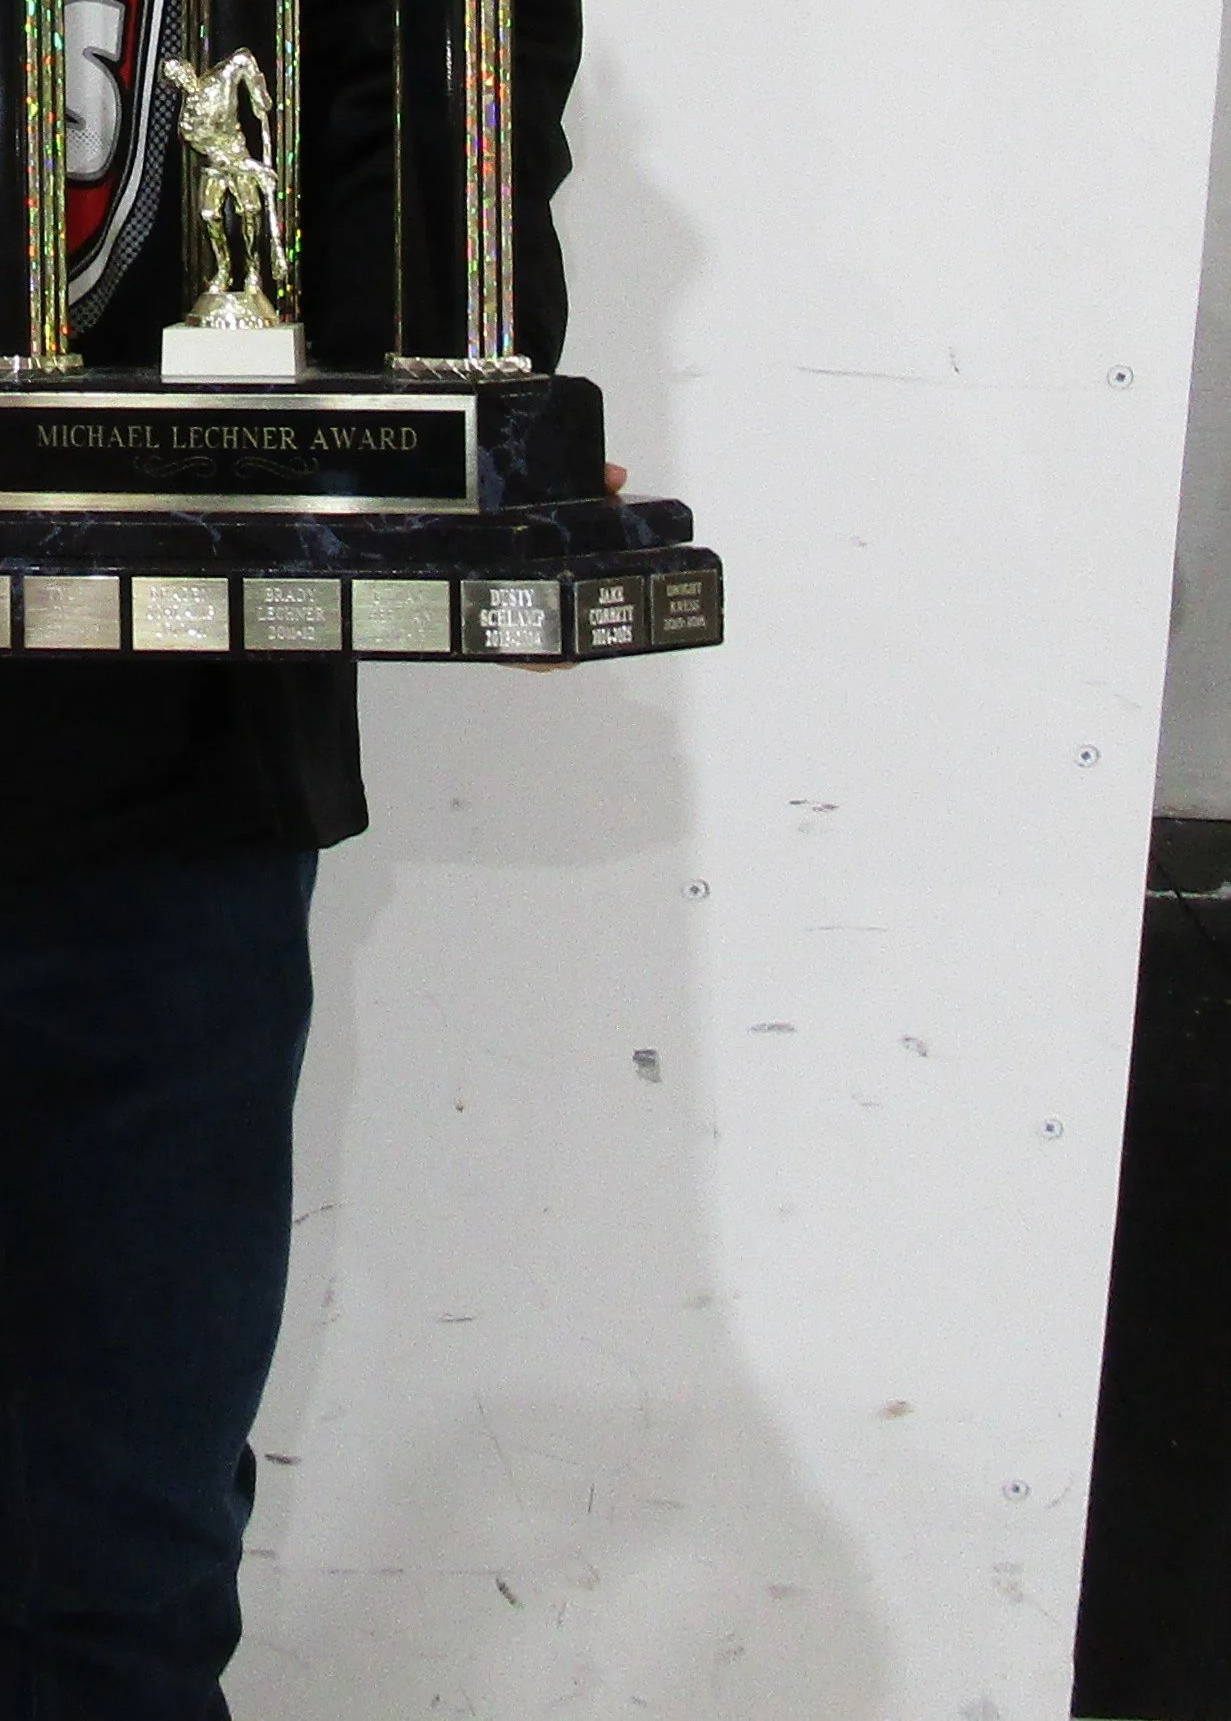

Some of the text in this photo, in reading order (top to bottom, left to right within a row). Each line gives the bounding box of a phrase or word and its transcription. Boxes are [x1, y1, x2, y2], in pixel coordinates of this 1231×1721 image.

[37, 424, 418, 451] MICHAEL LECHNER AWARD
